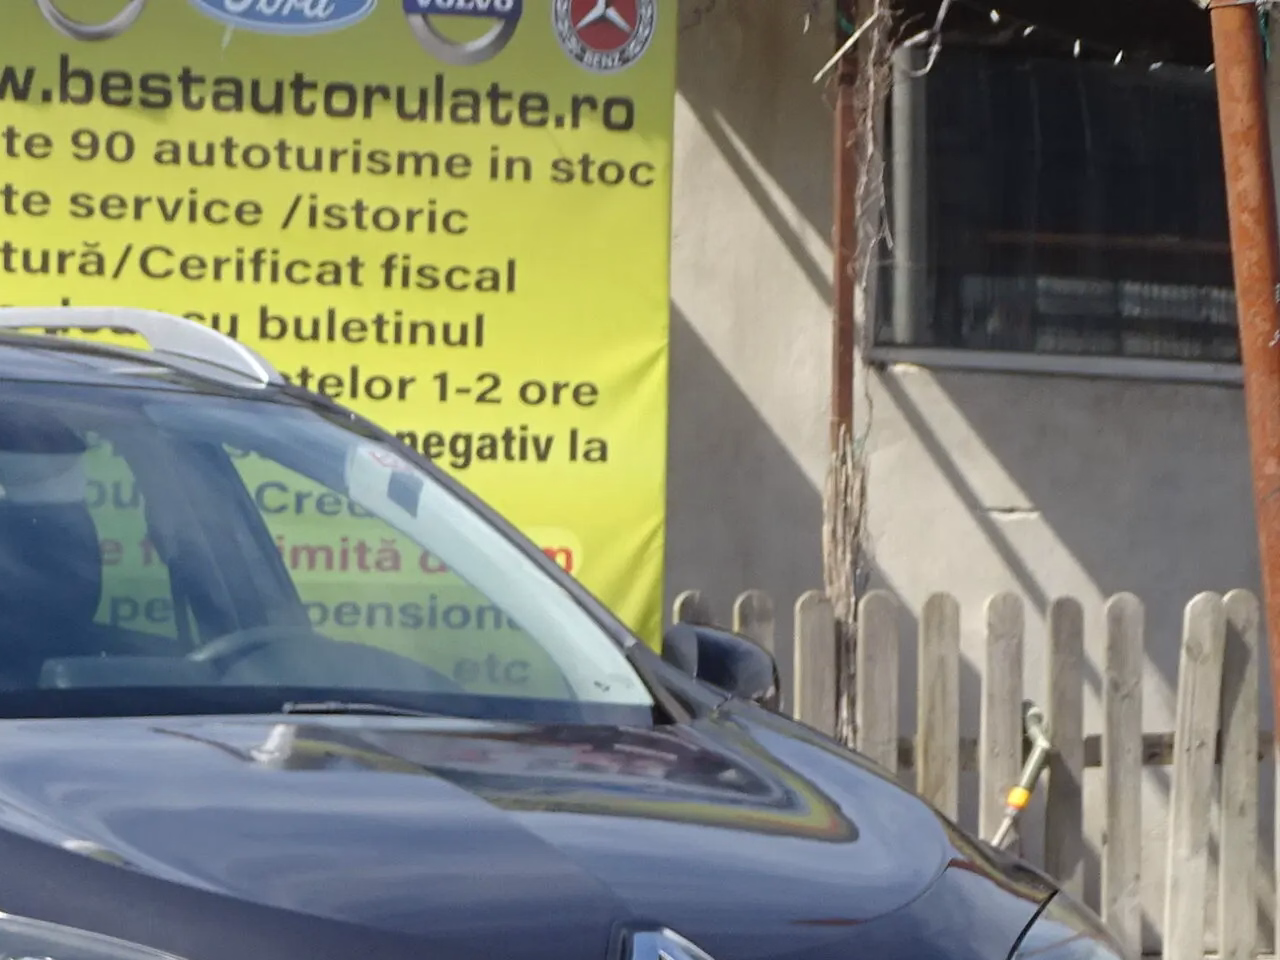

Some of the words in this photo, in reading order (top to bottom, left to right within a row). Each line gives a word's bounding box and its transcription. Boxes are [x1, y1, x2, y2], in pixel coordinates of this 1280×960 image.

[71, 128, 136, 163] 90
[153, 135, 472, 180] autoturisme
[489, 145, 533, 182] in
[549, 152, 657, 188] stoc
[69, 188, 263, 226] service
[380, 253, 517, 293] fiscal
[259, 304, 485, 348] buletinul
[432, 371, 502, 405] 1-2
[519, 378, 600, 408] ore
[569, 427, 609, 463] la
[453, 655, 532, 685] etc
